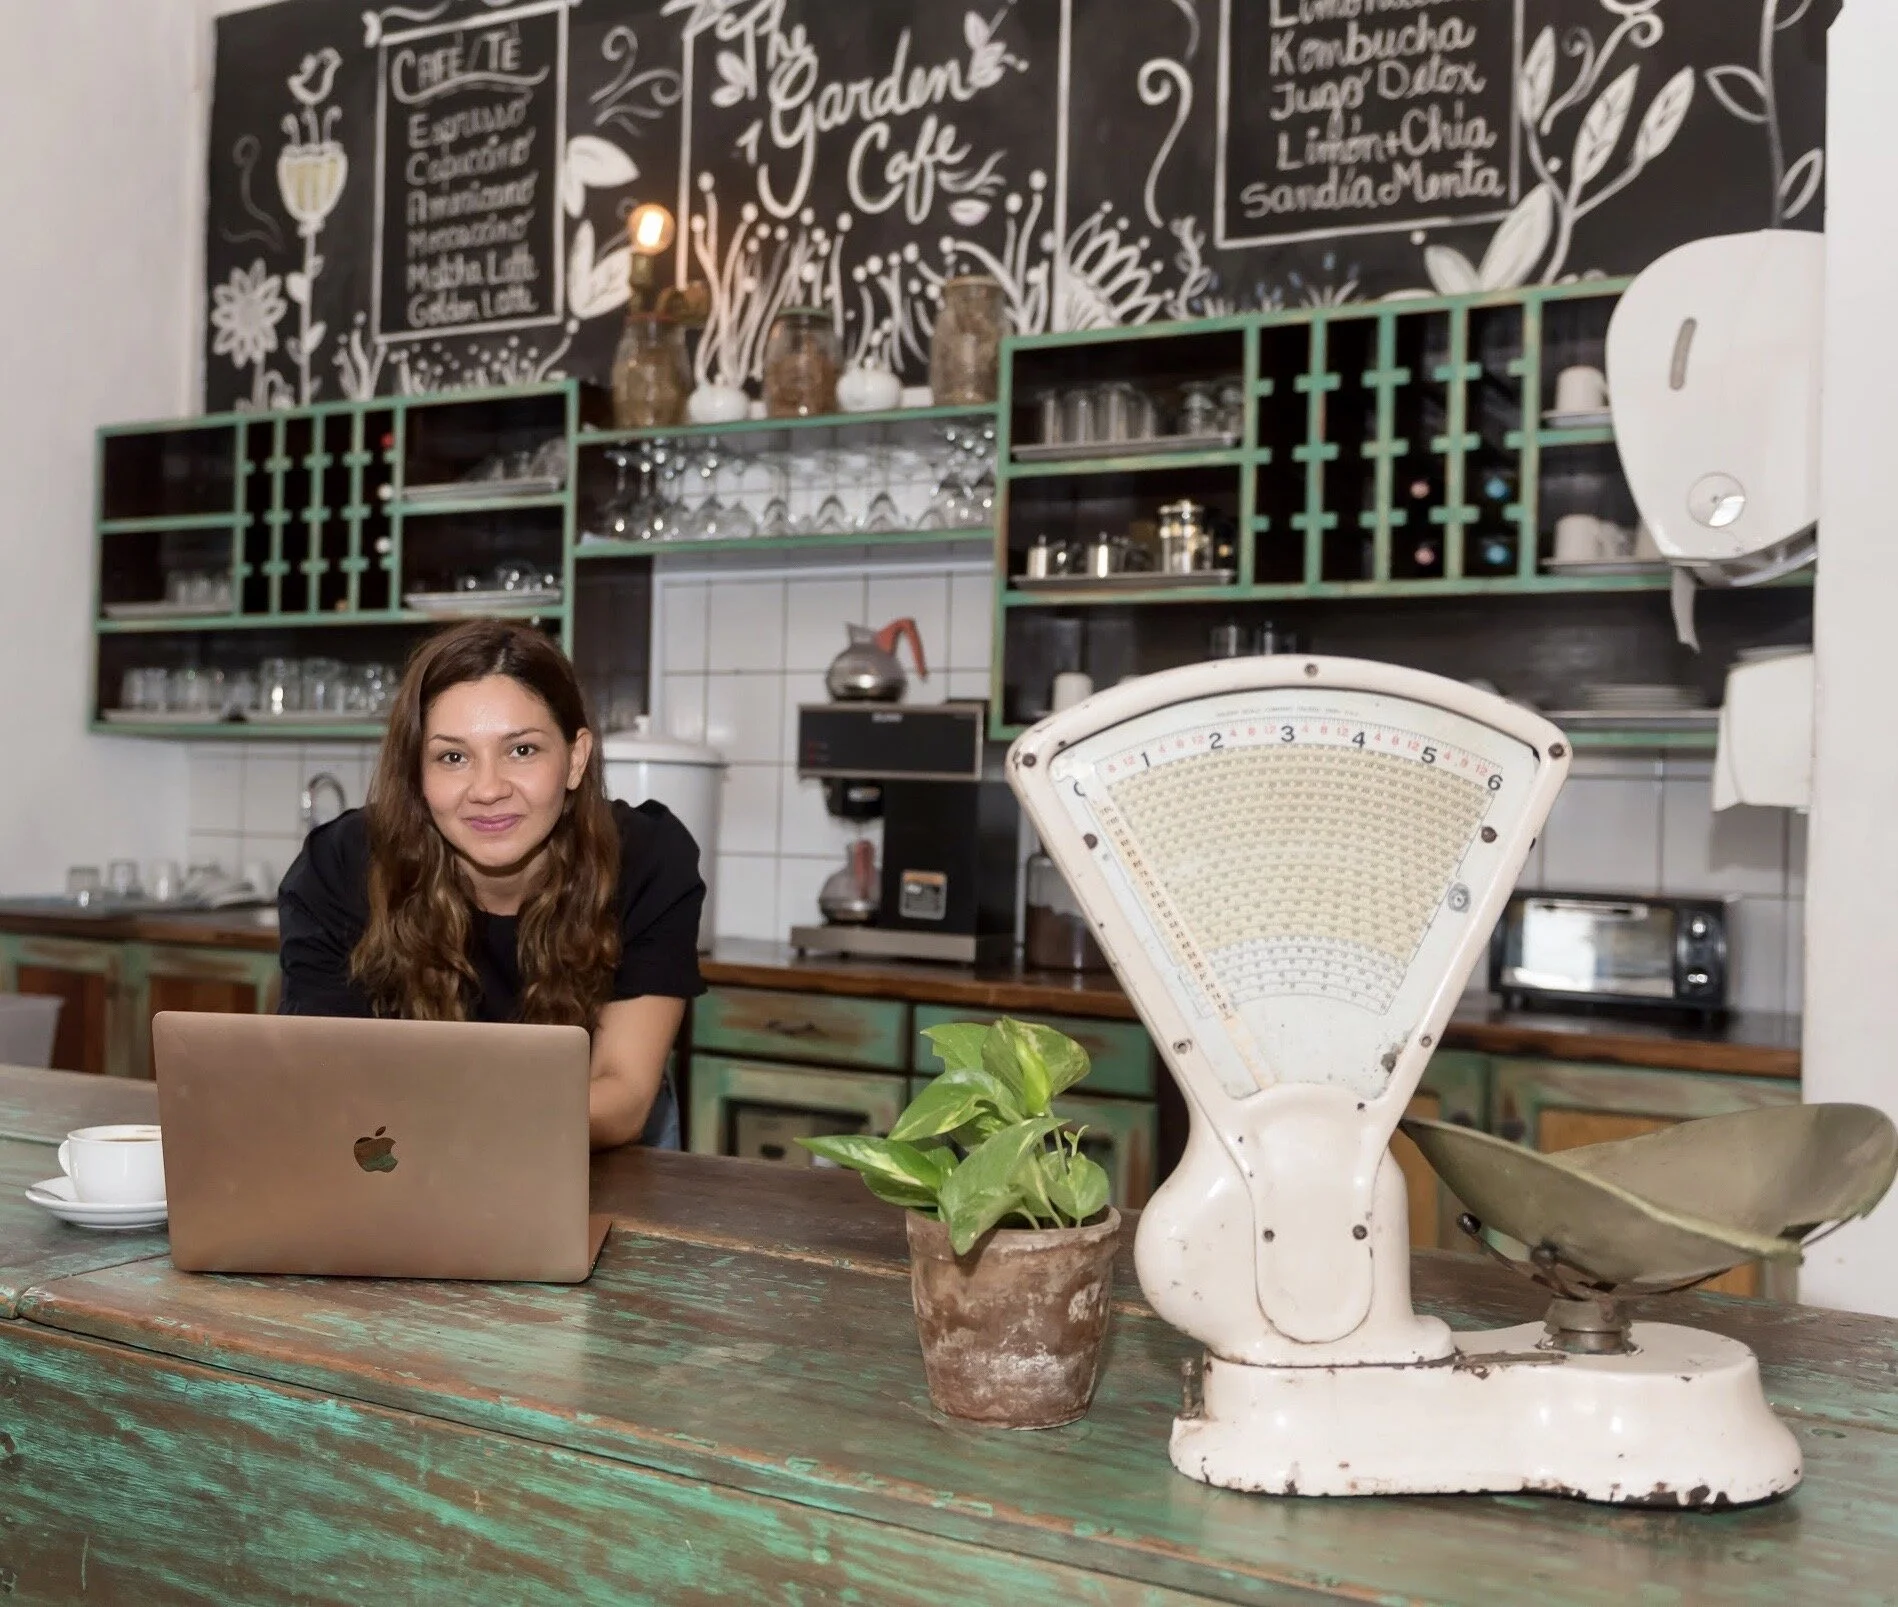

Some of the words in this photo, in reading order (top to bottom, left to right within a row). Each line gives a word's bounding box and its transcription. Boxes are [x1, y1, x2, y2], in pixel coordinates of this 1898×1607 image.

[1269, 11, 1477, 76] Kombucha
[757, 26, 978, 218] Garden
[1269, 66, 1373, 140] Jugo
[1391, 151, 1505, 203] Menta
[1141, 751, 1151, 768] 1
[1208, 732, 1224, 750] 2
[1280, 725, 1296, 743] 3
[1351, 731, 1366, 749] 4
[1421, 745, 1438, 765] 5
[1487, 774, 1504, 791] 6
